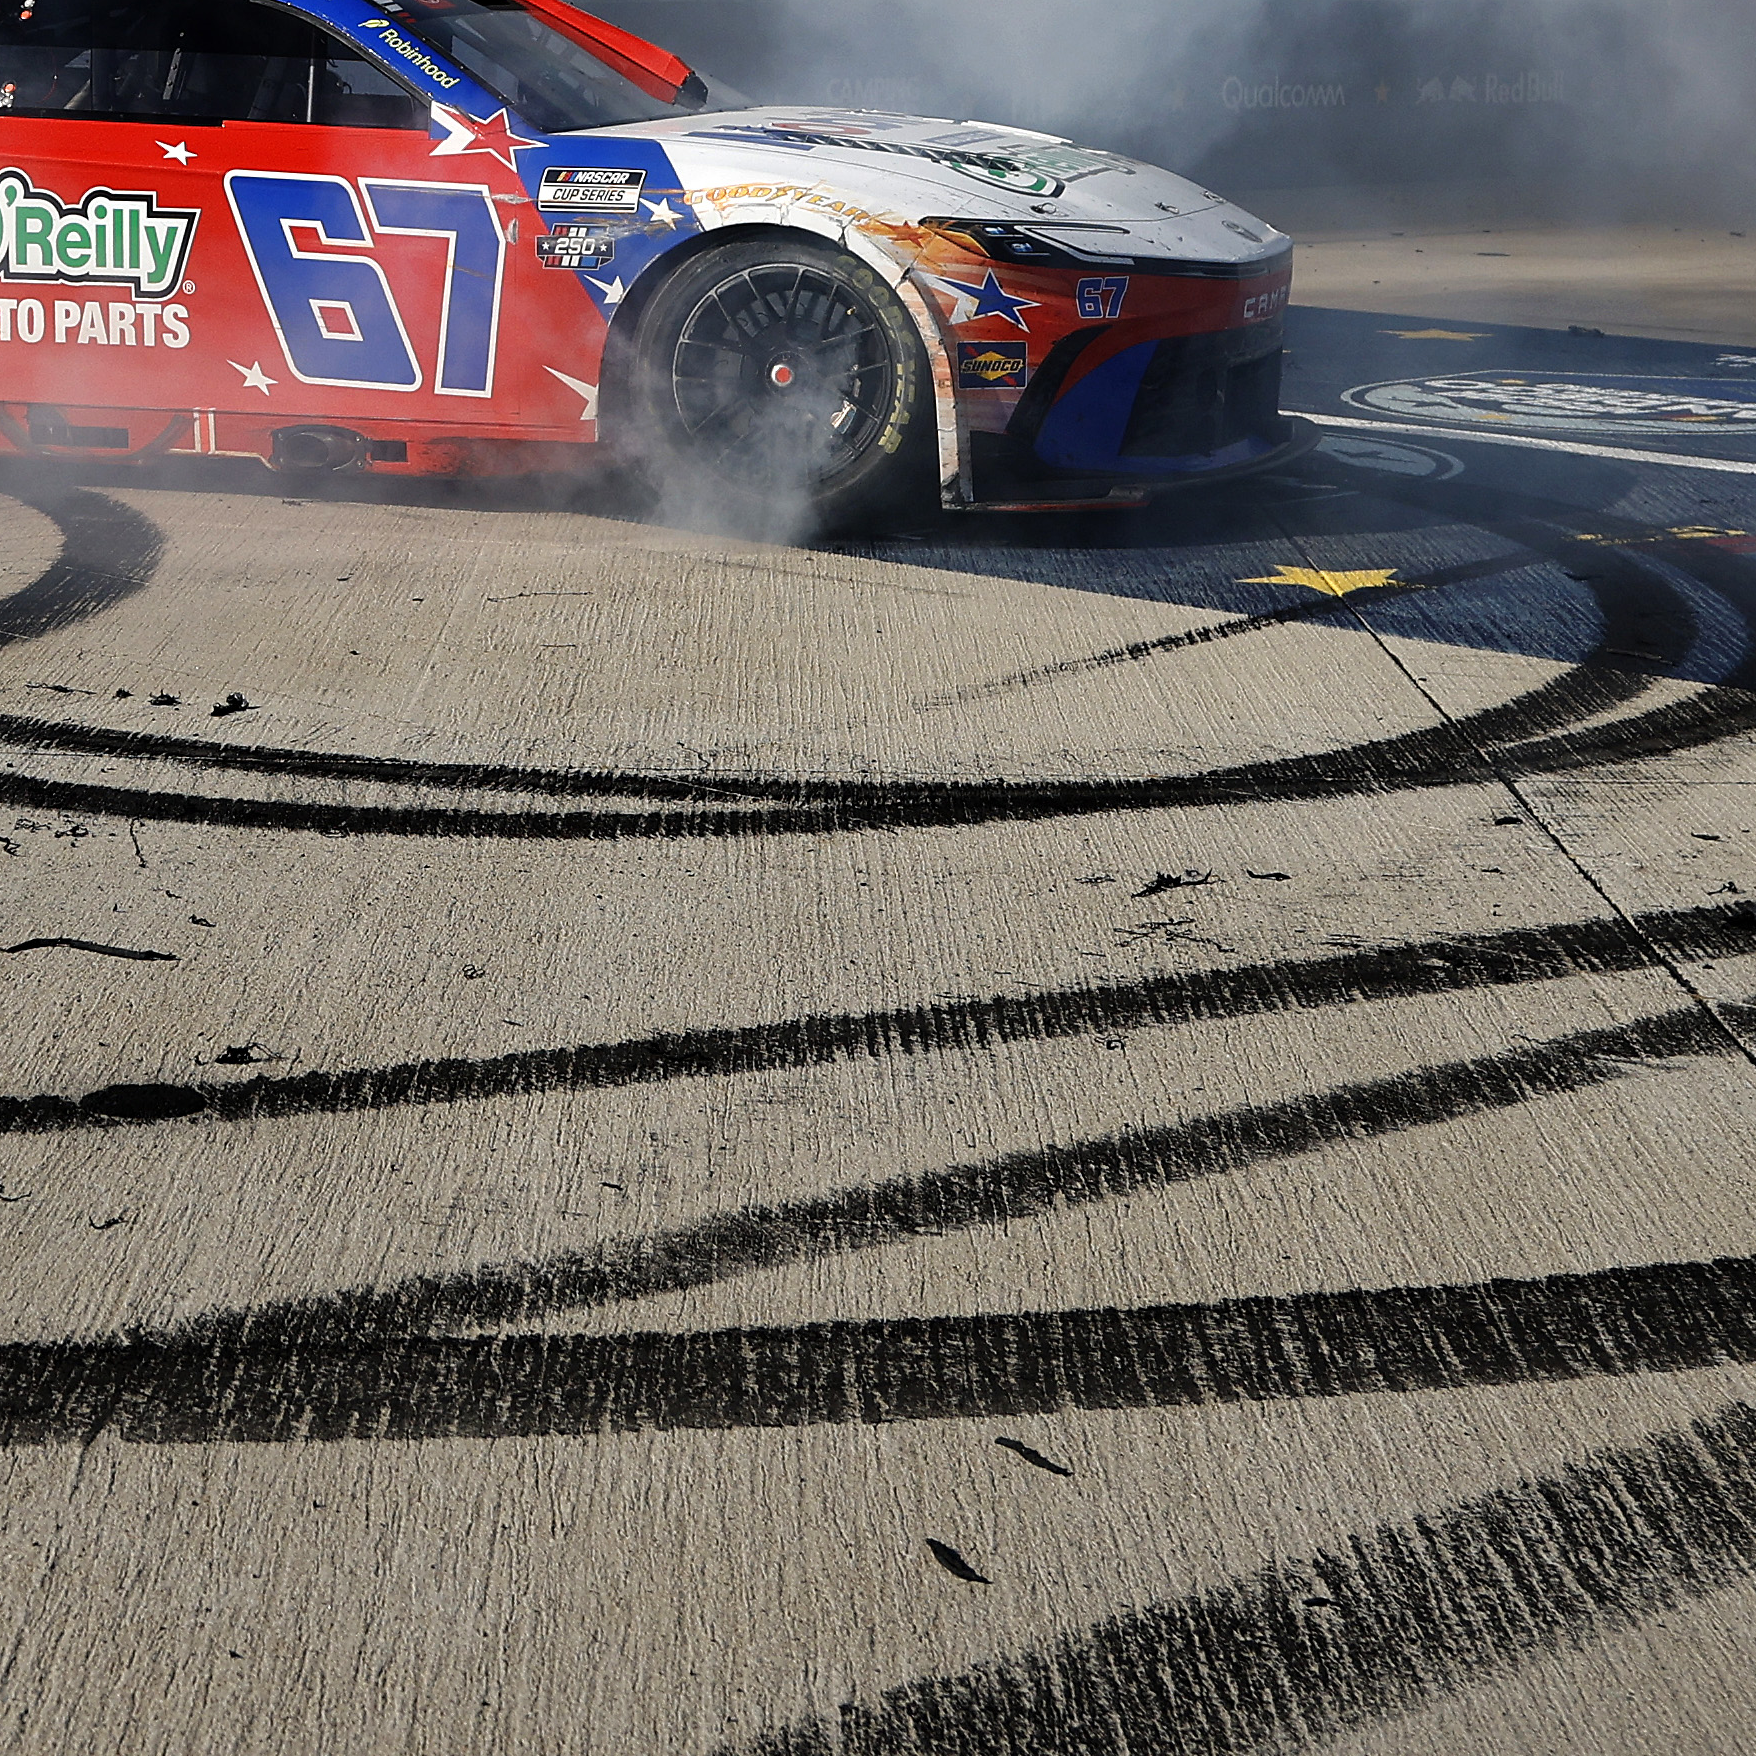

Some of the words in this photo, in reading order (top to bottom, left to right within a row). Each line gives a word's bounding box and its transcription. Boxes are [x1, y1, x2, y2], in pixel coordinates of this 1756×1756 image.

[378, 28, 461, 89] Robinhood
[1221, 74, 1345, 112] Qualcomm
[1485, 71, 1524, 104] Red
[1527, 69, 1566, 102] Bull
[552, 188, 580, 201] CUP
[579, 189, 626, 202] SERIES
[574, 171, 631, 184] NASCAR
[683, 185, 871, 223] GOODYEAR
[554, 237, 596, 255] 250
[223, 169, 507, 399] 67
[1076, 276, 1129, 319] 67
[54, 300, 191, 349] PARTS
[961, 357, 1025, 374] SUNOCO
